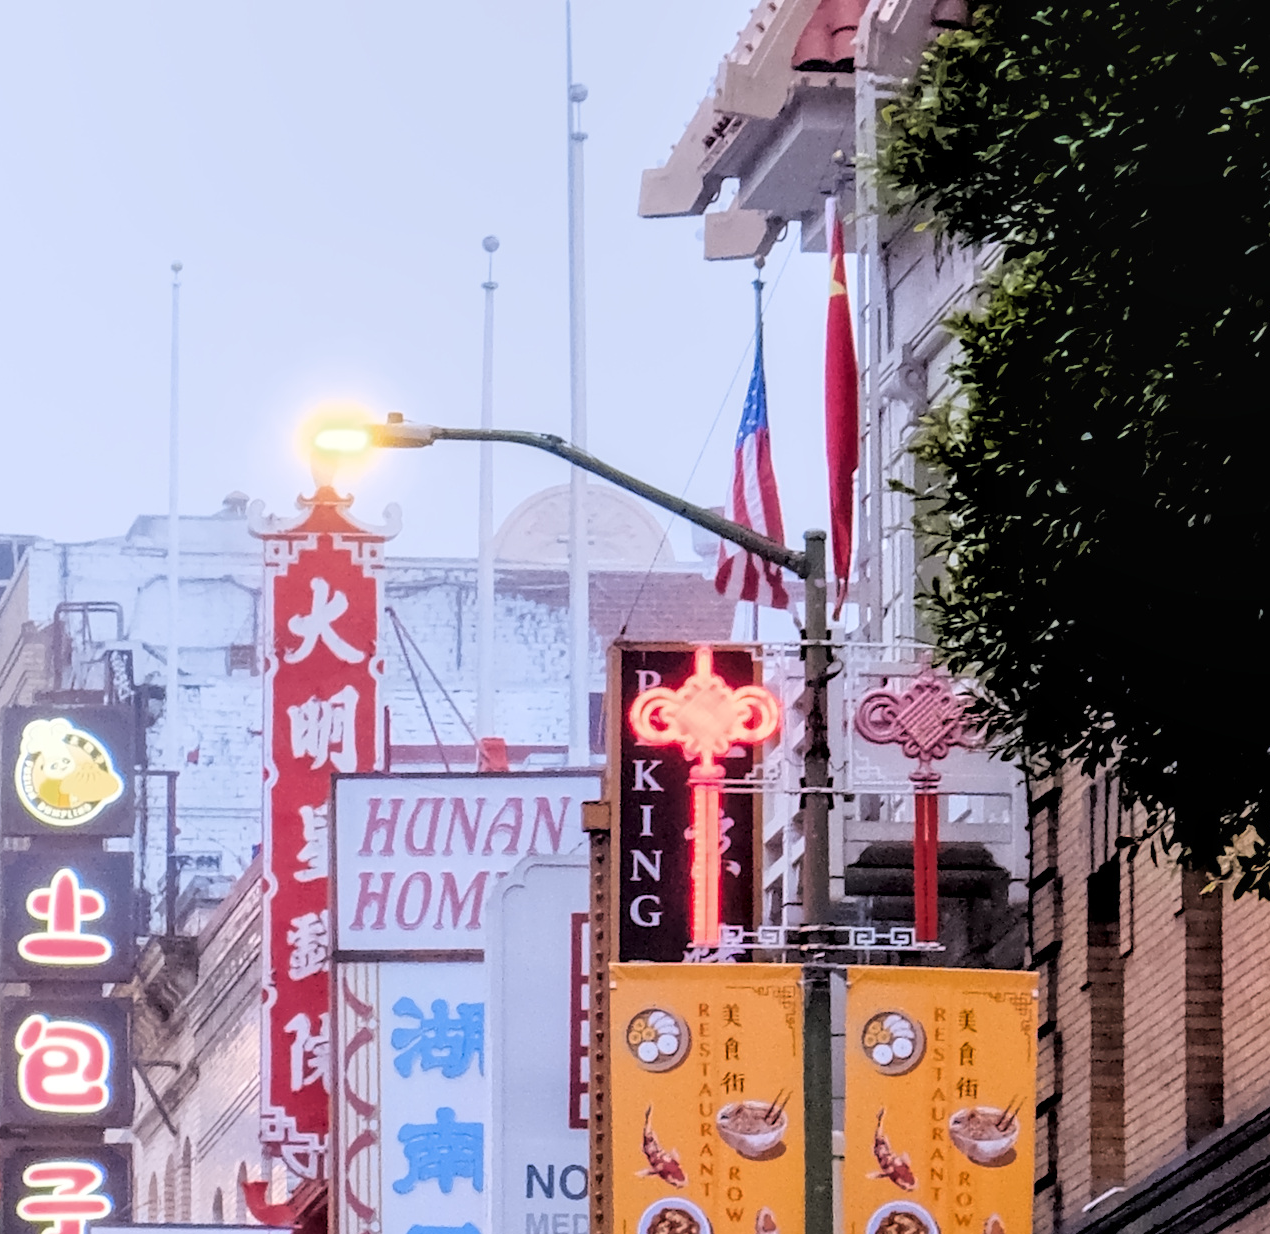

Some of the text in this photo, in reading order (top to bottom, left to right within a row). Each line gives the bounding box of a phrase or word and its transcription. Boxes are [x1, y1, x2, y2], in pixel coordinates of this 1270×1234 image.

[359, 797, 572, 857] HUNAN
[629, 670, 664, 927] PKING
[349, 869, 507, 932] HOM
[720, 1002, 745, 1095] 美食街
[956, 1008, 979, 1100] 美食街
[698, 1003, 713, 1198] RESTAURANT
[929, 1007, 946, 1203] RESTAURANT
[727, 1165, 744, 1223] ROW
[955, 1172, 973, 1227] ROW
